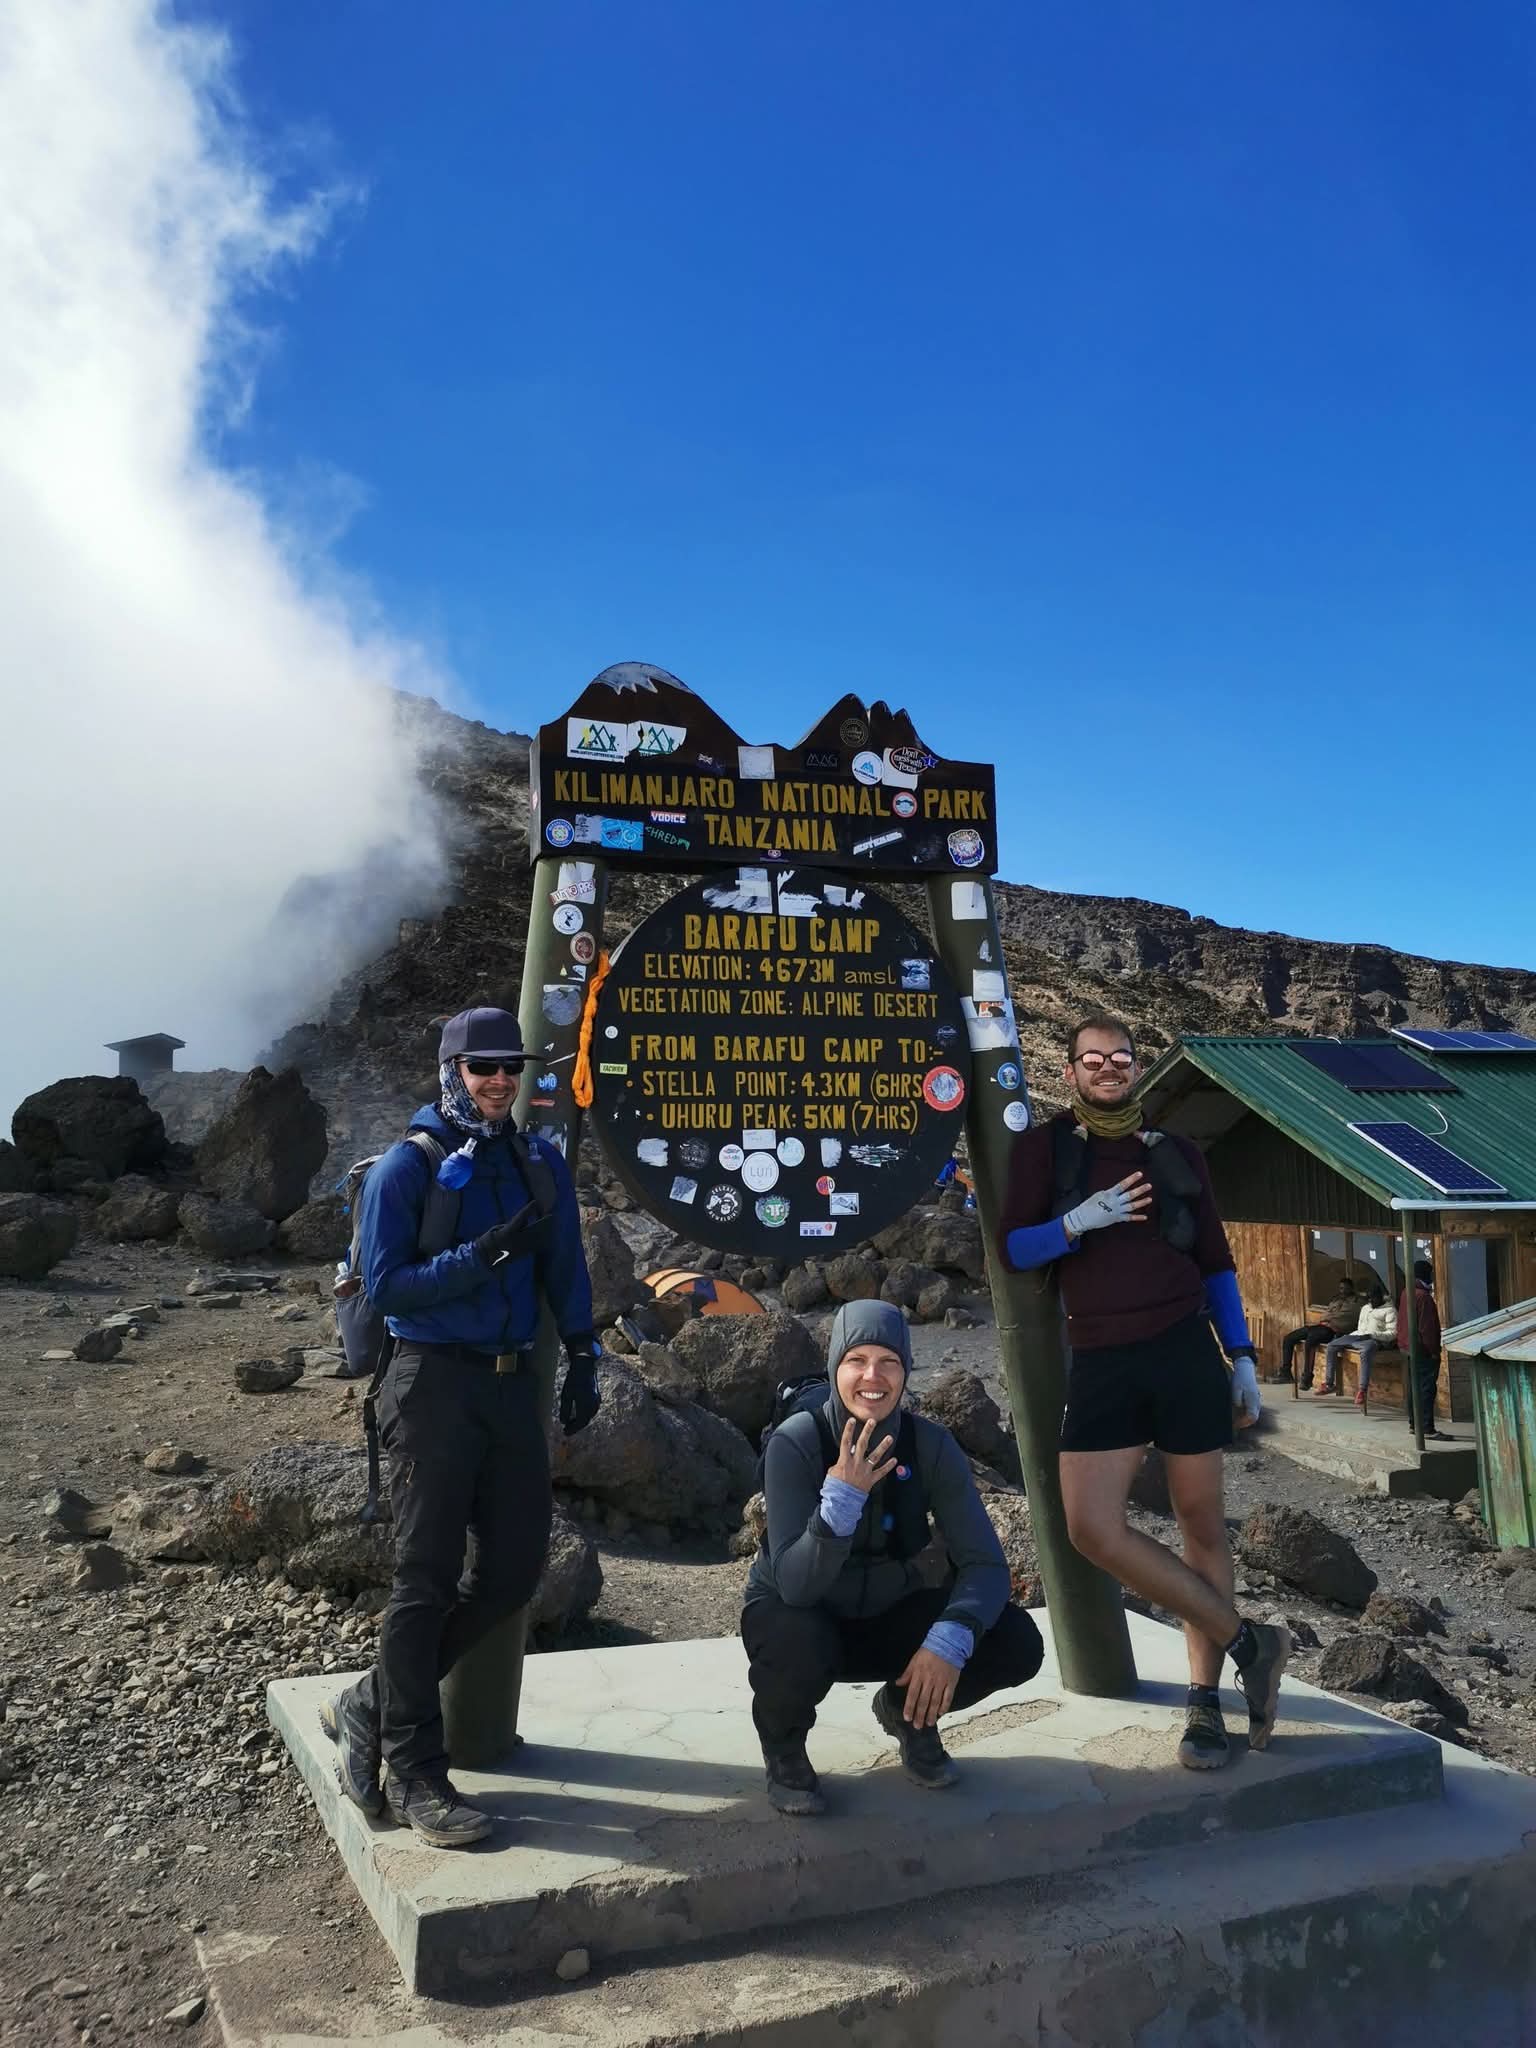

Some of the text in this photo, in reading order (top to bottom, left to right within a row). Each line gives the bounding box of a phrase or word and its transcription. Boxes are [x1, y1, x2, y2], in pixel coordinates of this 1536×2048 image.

[555, 770, 736, 809] KILIMANJARO
[761, 781, 891, 817] NATIONAL
[924, 788, 988, 820] PARK
[651, 811, 687, 824] VODICE
[704, 814, 837, 852] TANZANIA
[685, 914, 880, 954] BARAFU CAMP
[645, 954, 897, 985] ELEVATION: 4673M amsl
[618, 988, 938, 1018] VEGETATION ZONE: ALPINE DESERT
[631, 1035, 697, 1062] FROM
[714, 1036, 805, 1062] BARAFU
[824, 1038, 883, 1062] CAMP
[643, 1071, 716, 1097] STELLA
[736, 1071, 797, 1097] POINT:
[801, 1072, 861, 1097] 4.3KM
[661, 1100, 918, 1137] UHURU PEAK: 5KM (7HRS)
